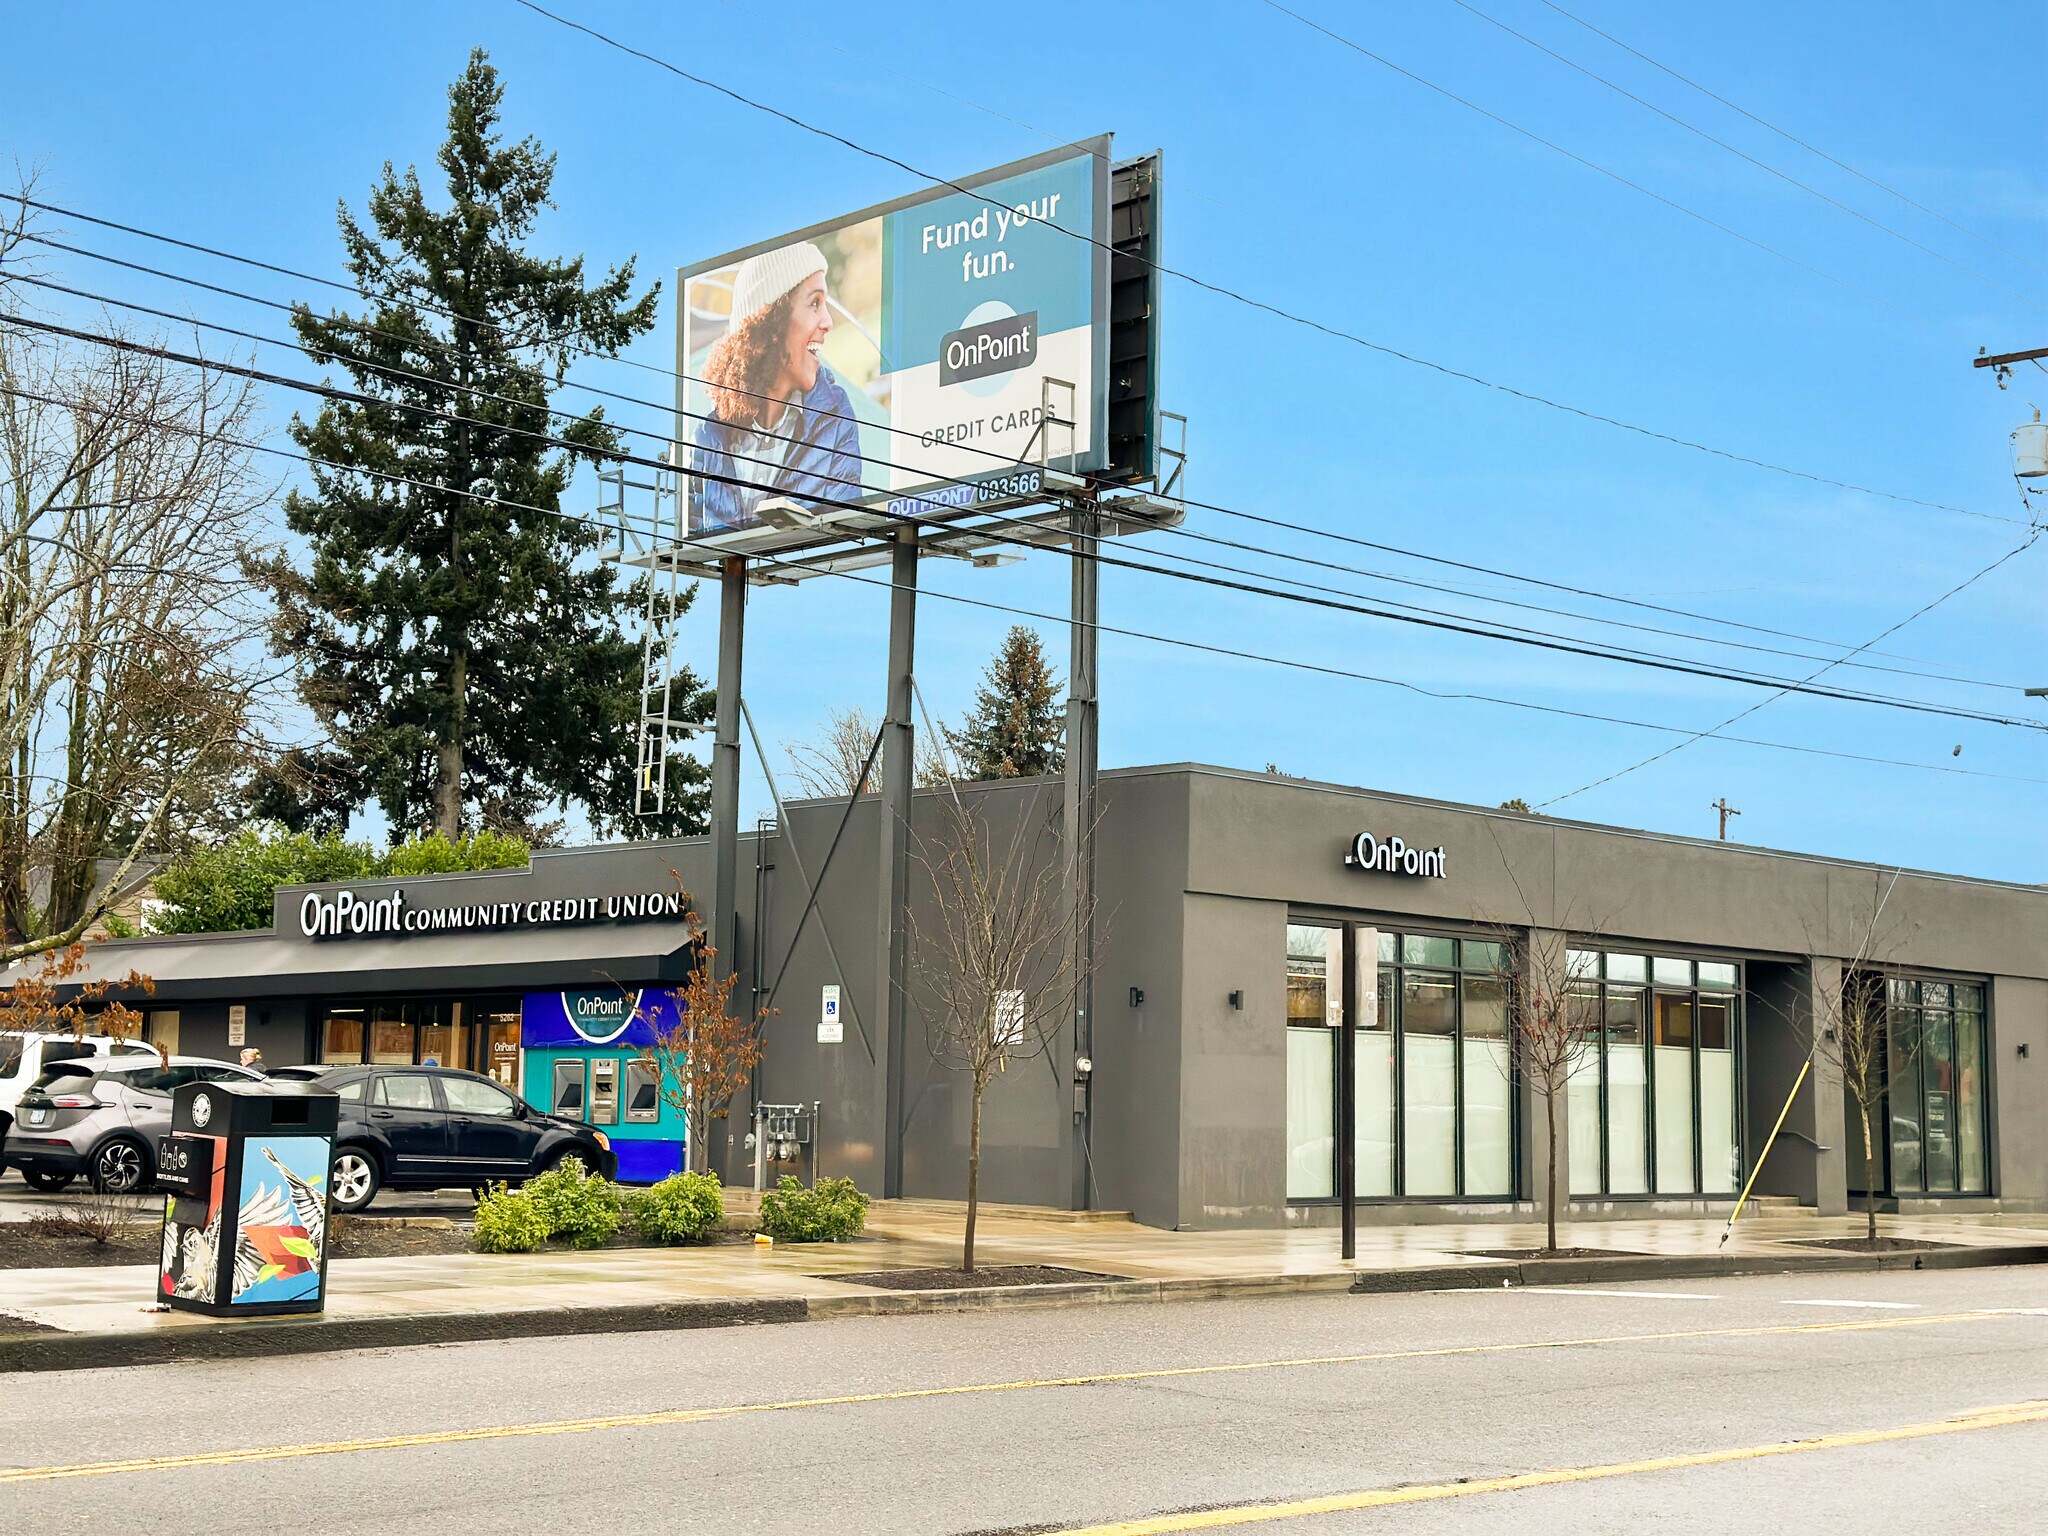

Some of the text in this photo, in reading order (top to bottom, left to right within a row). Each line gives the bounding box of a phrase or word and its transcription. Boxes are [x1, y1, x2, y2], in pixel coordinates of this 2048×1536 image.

[922, 193, 1061, 254] Fund your
[962, 249, 1015, 283] fun.
[946, 325, 1031, 370] OnPoint
[921, 419, 985, 448] CREDIT
[889, 472, 1040, 516] OUTFRONT 093566
[1357, 831, 1447, 879] OnPoint
[300, 889, 680, 938] OnPoint COMMUNITY CREDIT UNION
[577, 996, 623, 1016] OnPoint
[494, 1042, 517, 1052] OnPoint
